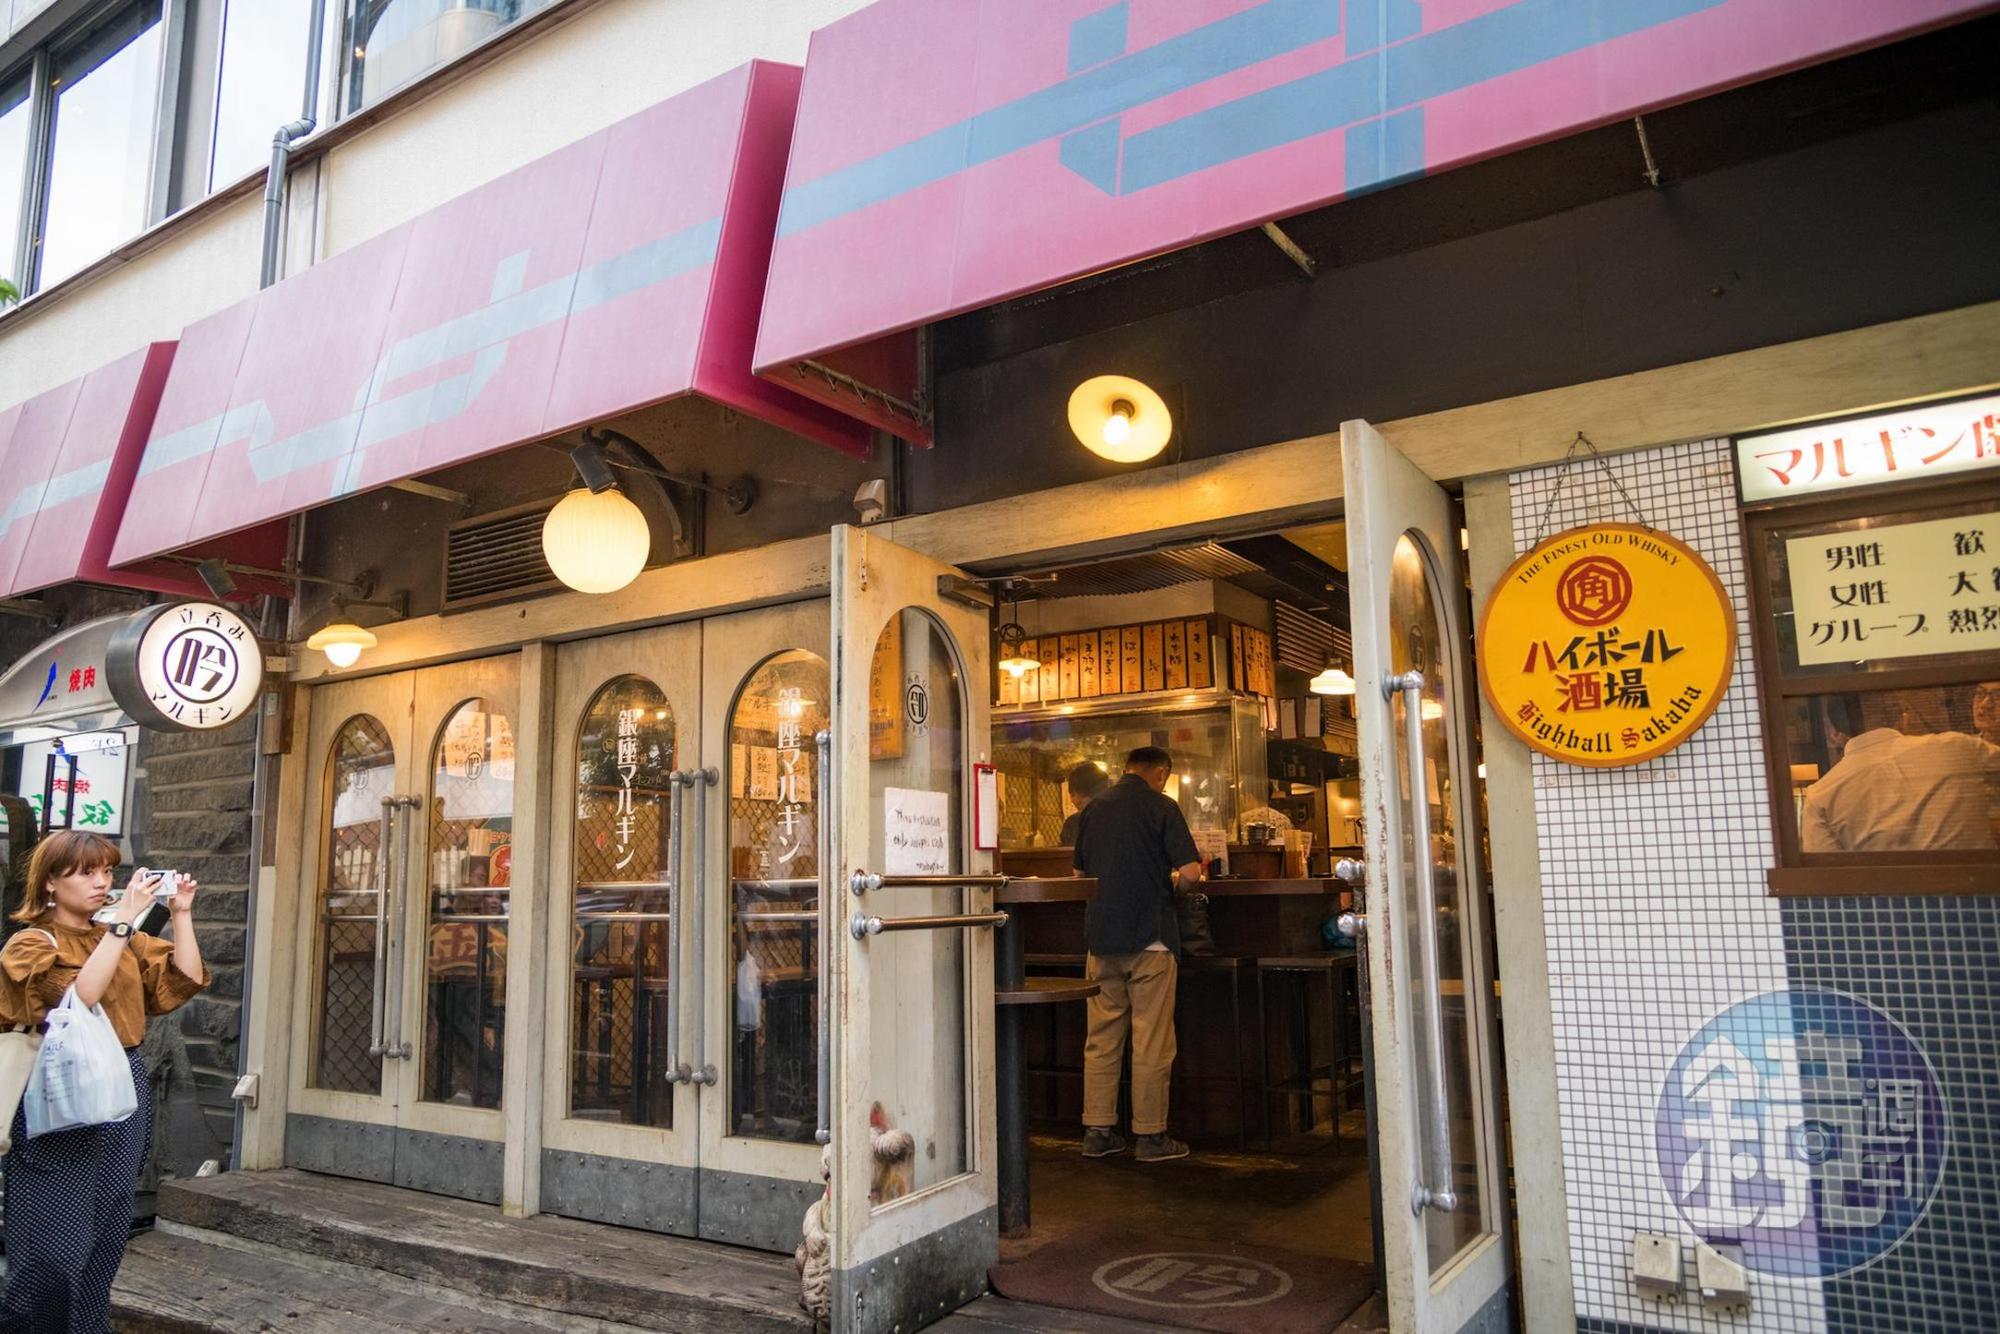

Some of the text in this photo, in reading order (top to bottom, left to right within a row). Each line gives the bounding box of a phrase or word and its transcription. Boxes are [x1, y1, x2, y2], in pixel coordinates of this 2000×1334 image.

[1517, 532, 1681, 585] THE FINEST OLD WHISKY
[1826, 529, 1986, 571] 男性 歓
[1575, 571, 1612, 609] 角
[1829, 581, 1890, 609] 女性
[180, 607, 245, 641] 立呑み
[1810, 613, 1930, 647] グループ
[1522, 626, 1684, 673] ハイボール
[68, 665, 96, 693] 焼肉
[1555, 668, 1651, 713] 酒場
[152, 690, 233, 724] マルギン
[1517, 684, 1703, 754] Highball Sakaba
[615, 709, 638, 870] 銀座マルギン
[778, 687, 802, 865] 銀座マルギン
